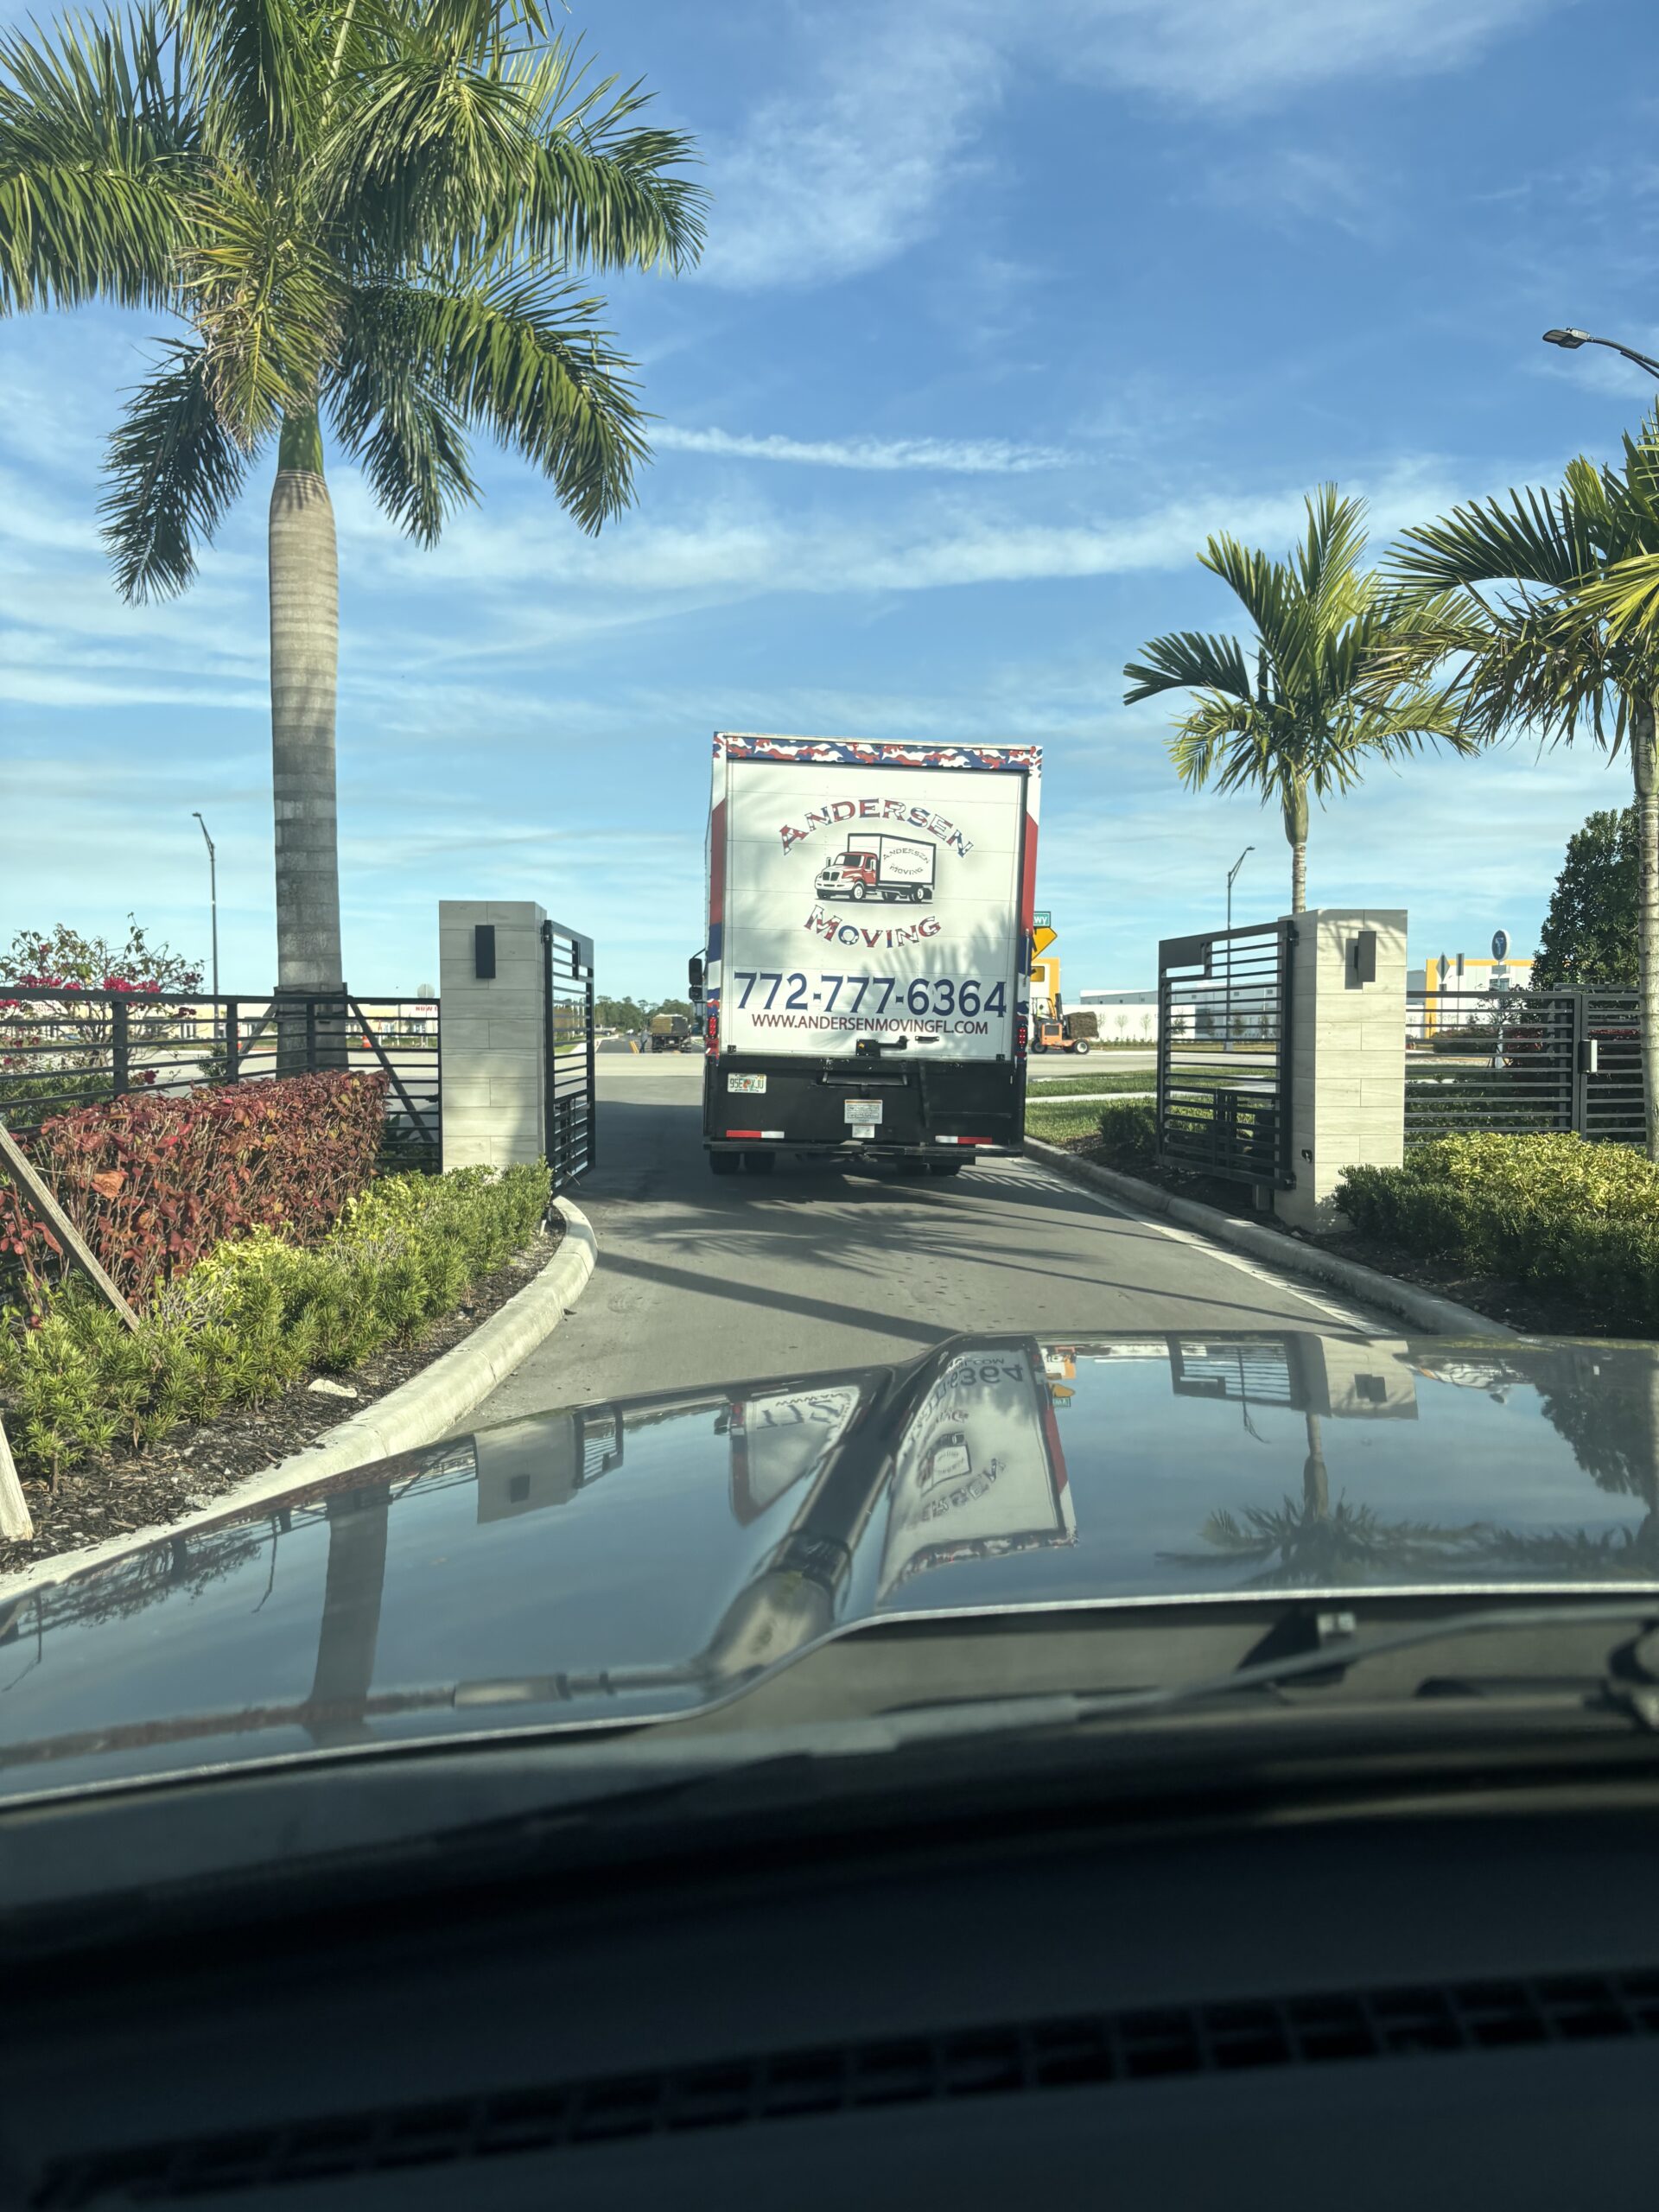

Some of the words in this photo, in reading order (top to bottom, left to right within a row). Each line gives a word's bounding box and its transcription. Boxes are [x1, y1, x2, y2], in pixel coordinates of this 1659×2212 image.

[779, 798, 974, 858] ANDERSEN
[883, 848, 931, 864] ANDERSEN
[889, 863, 924, 875] MOVING
[804, 905, 942, 948] MOVING
[1033, 916, 1047, 925] wy
[734, 971, 1007, 1018] 772-777-6364
[752, 1014, 988, 1034] WWW.ANDERSENMOVINGFL.COM
